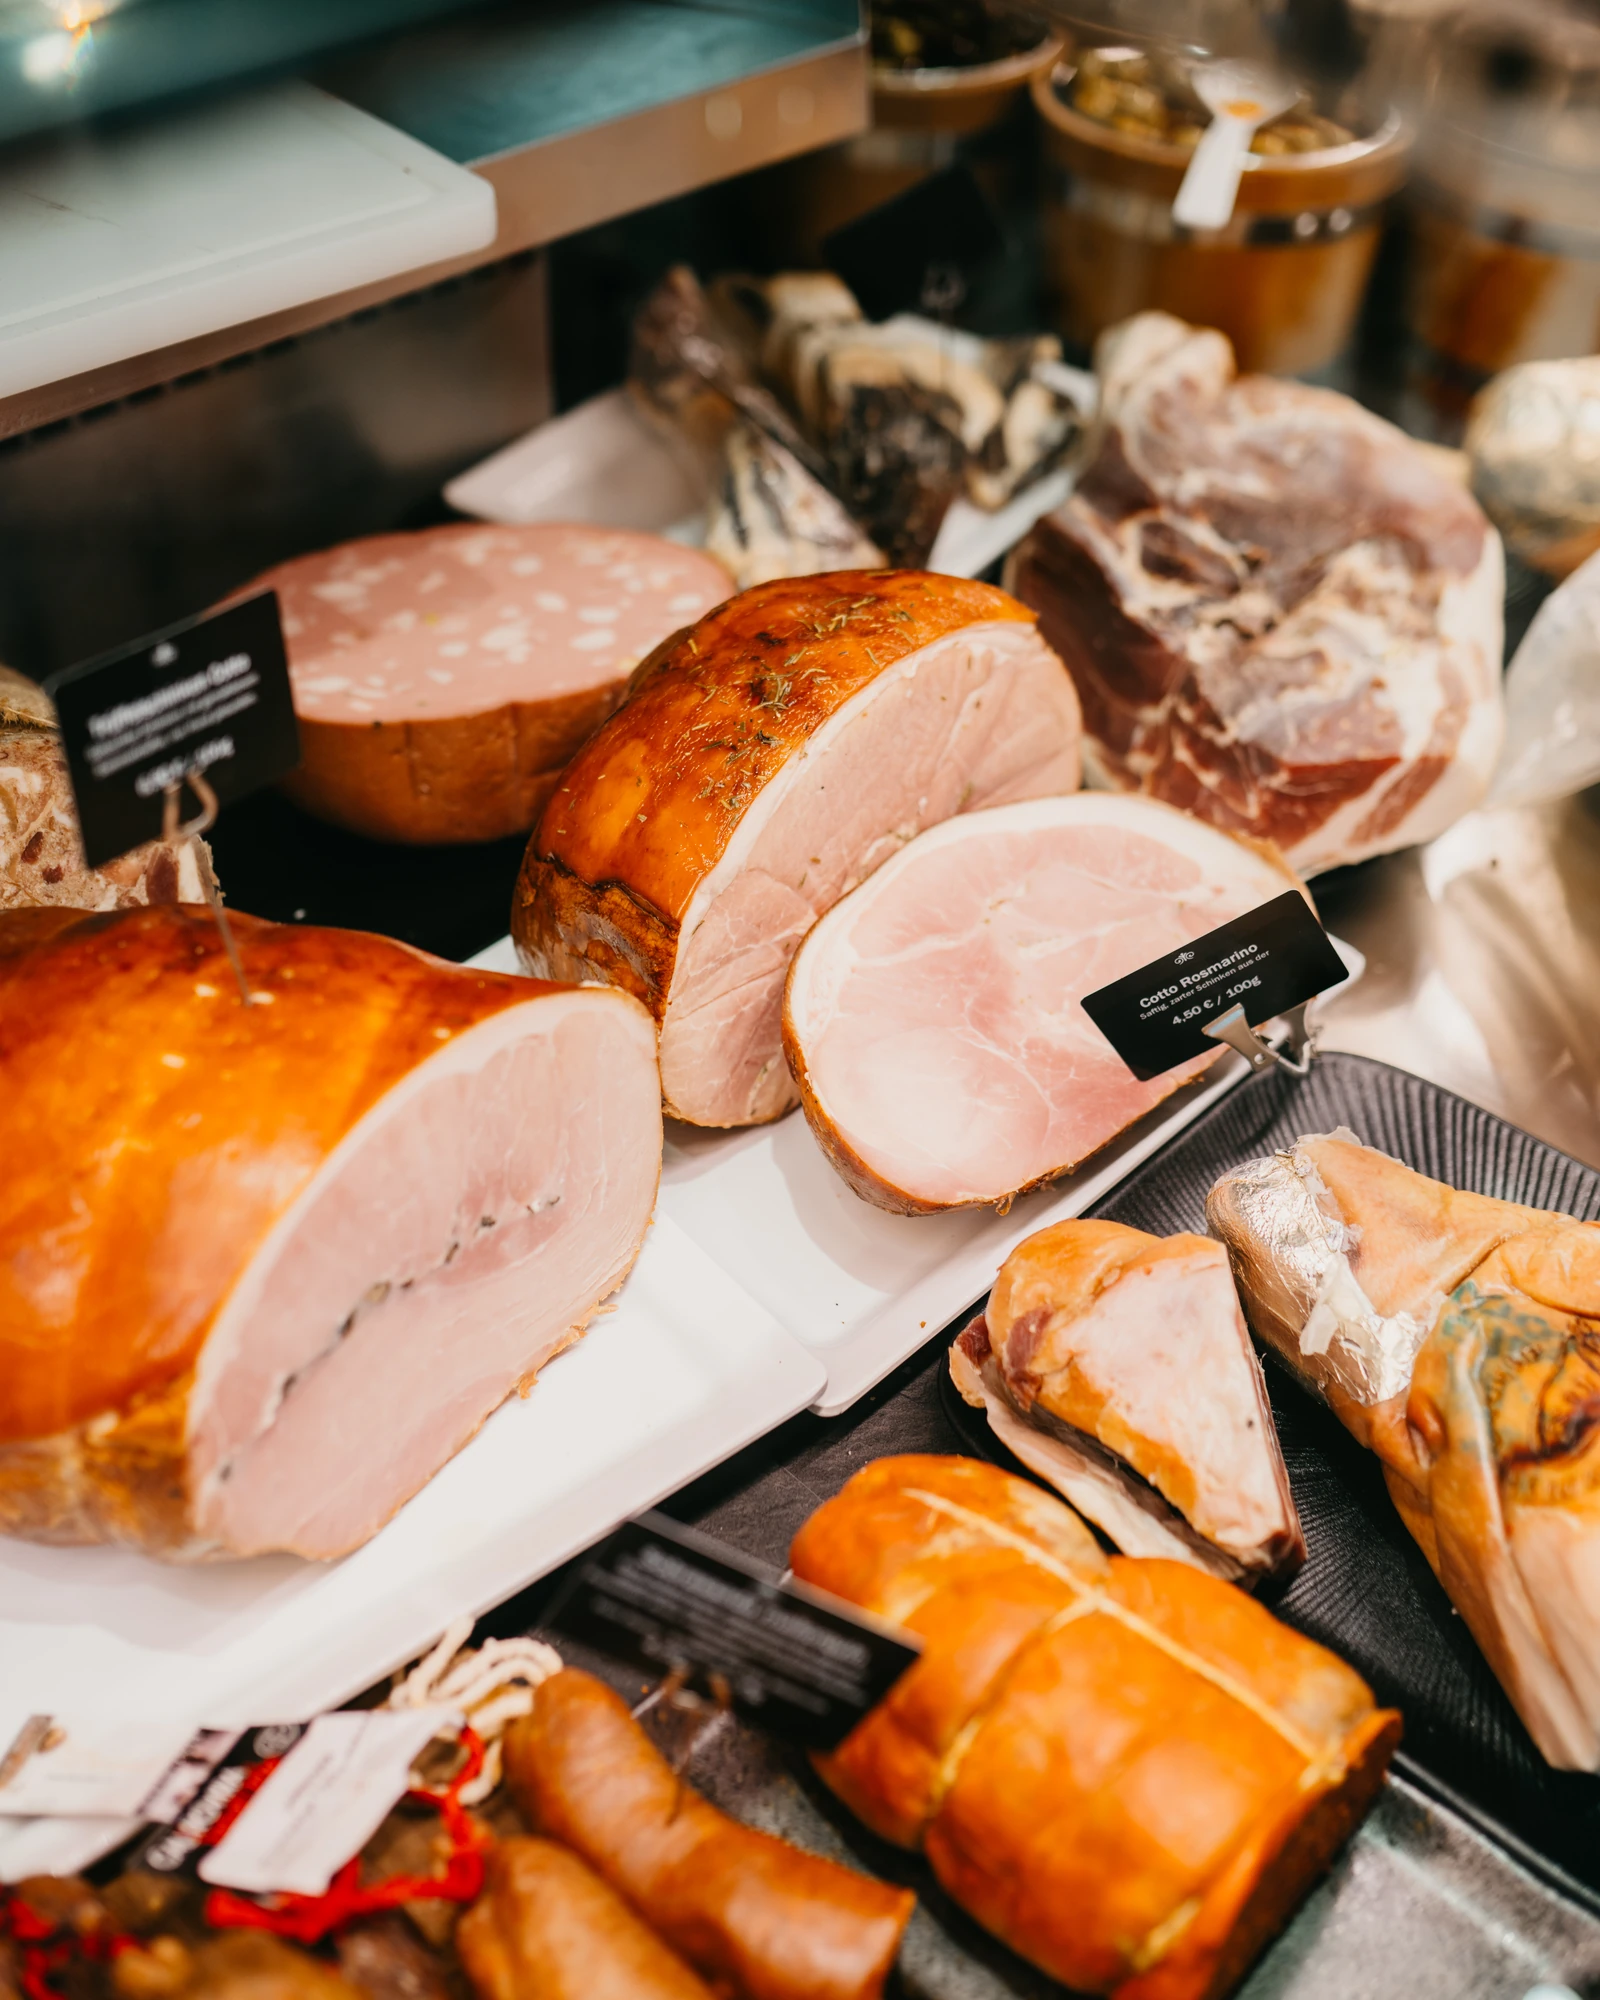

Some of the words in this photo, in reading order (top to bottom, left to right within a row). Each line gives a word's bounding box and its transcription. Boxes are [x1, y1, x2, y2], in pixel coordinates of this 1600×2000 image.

[1139, 985, 1178, 1008] Cotto
[1179, 944, 1258, 988] Rosmarino
[1139, 1002, 1169, 1020] Saftig,
[1170, 989, 1195, 1006] zarter
[1195, 968, 1237, 992] Schinken
[1237, 960, 1254, 971] aus
[1255, 950, 1270, 962] der
[1172, 1005, 1202, 1026] 4,50
[1202, 998, 1215, 1010] €
[1225, 975, 1261, 998] 100g
